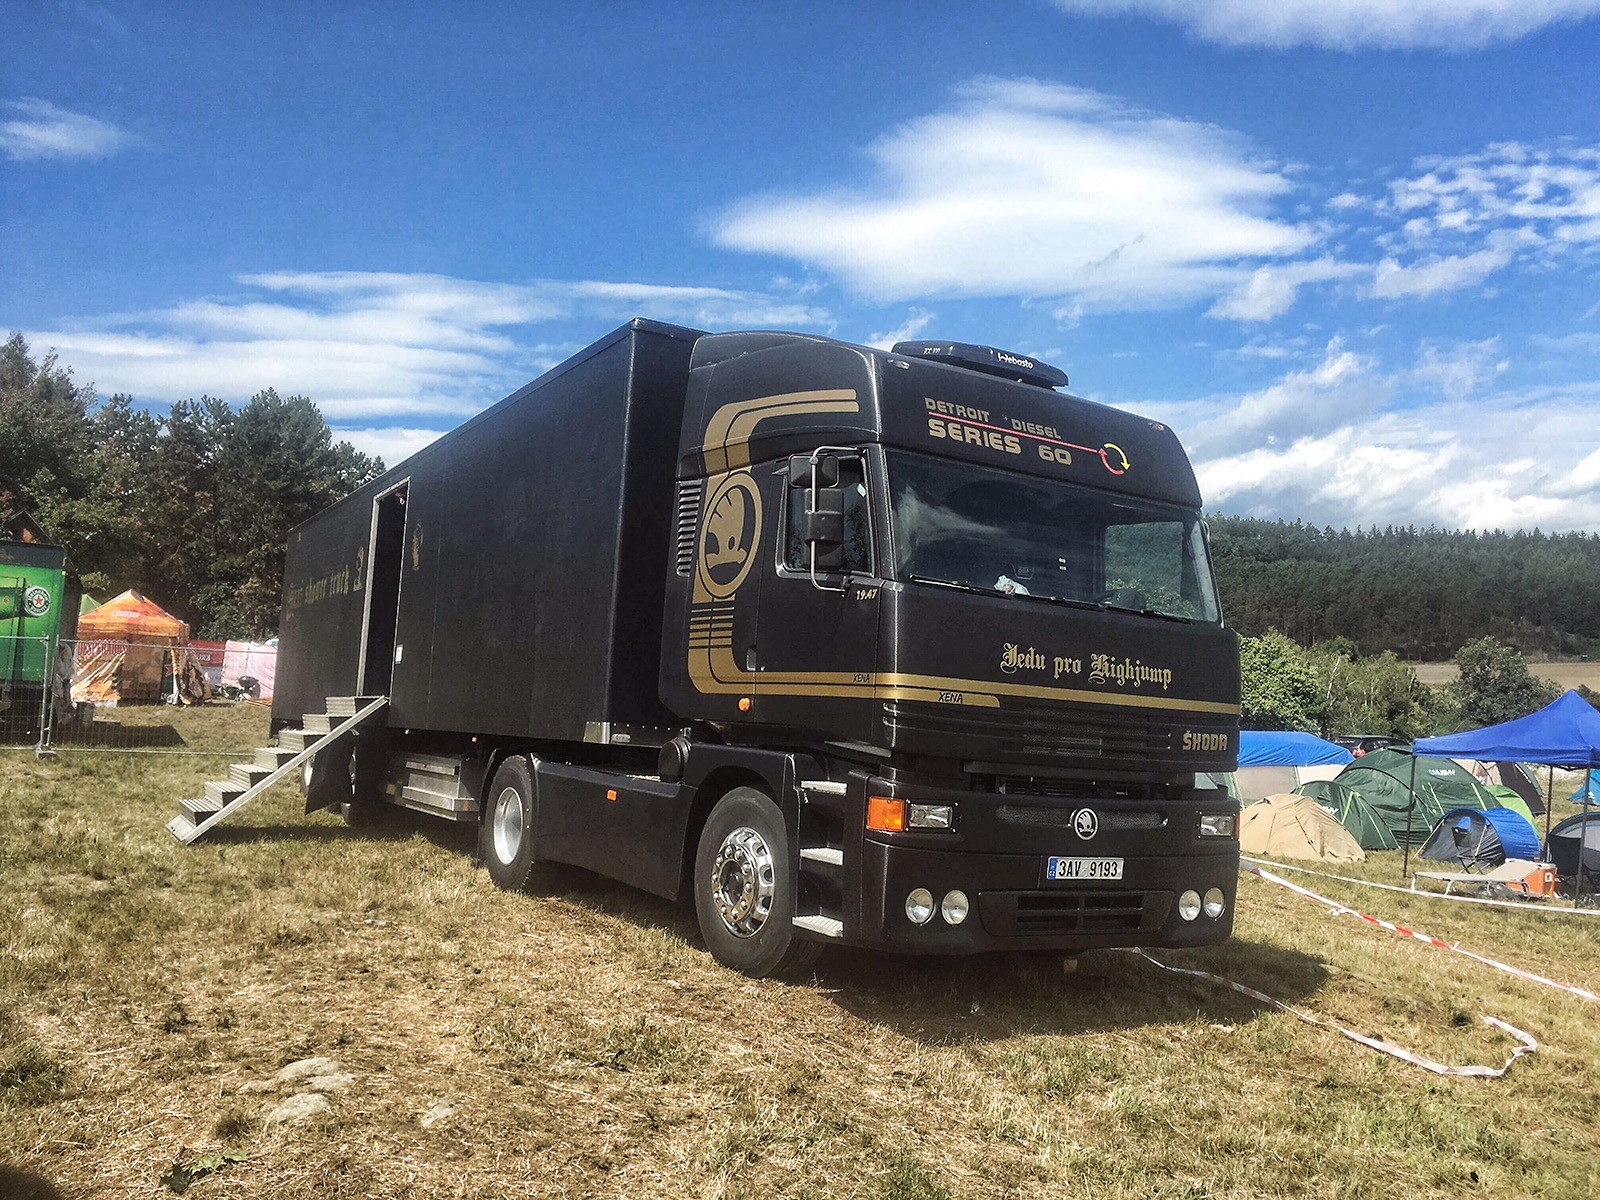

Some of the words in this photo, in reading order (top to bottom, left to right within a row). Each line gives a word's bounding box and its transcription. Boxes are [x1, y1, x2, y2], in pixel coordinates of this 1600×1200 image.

[997, 352, 1034, 369] Webasto
[925, 397, 989, 423] DETROIT
[1011, 418, 1061, 440] DIESEL
[928, 418, 1022, 455] SERIES
[1038, 444, 1072, 465] 60
[856, 589, 878, 600] 19.47
[1000, 642, 1046, 674] Jedu
[1053, 656, 1082, 680] pro
[1088, 653, 1172, 691] Highjump
[853, 674, 870, 684] XENA
[938, 691, 963, 703] XENA
[1058, 860, 1082, 877] 3AV
[1089, 861, 1118, 877] 9193
